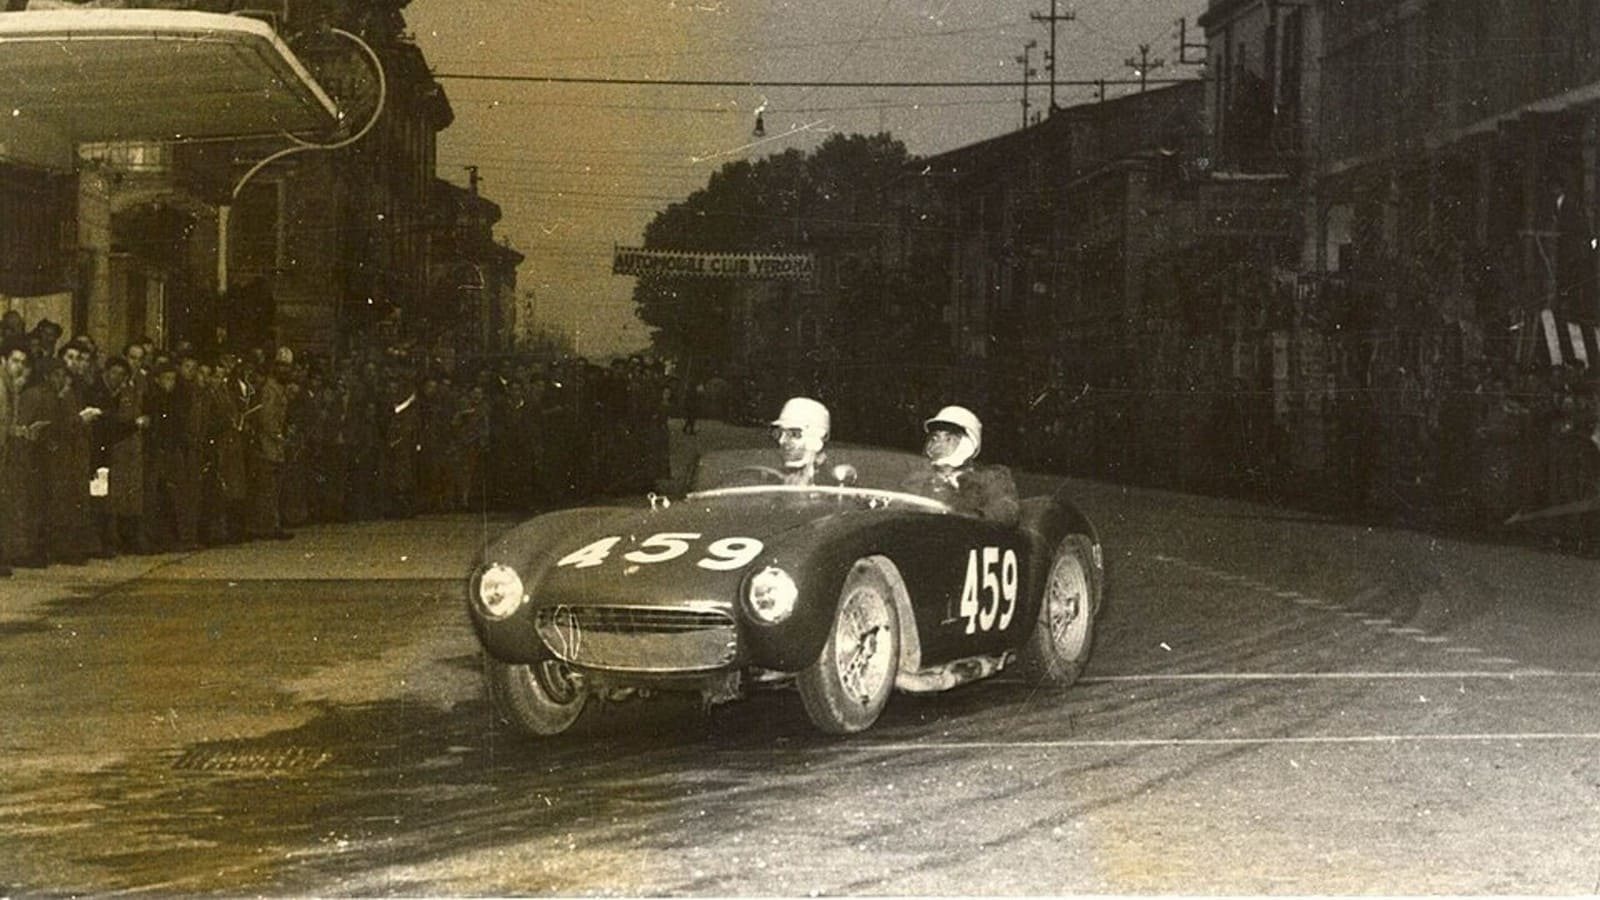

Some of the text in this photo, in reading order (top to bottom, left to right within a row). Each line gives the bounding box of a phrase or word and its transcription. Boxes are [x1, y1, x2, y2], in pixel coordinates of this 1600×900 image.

[614, 253, 813, 274] AUTOMOBILE CLUB VERONA
[557, 532, 764, 571] 459
[960, 546, 1018, 635] 459
